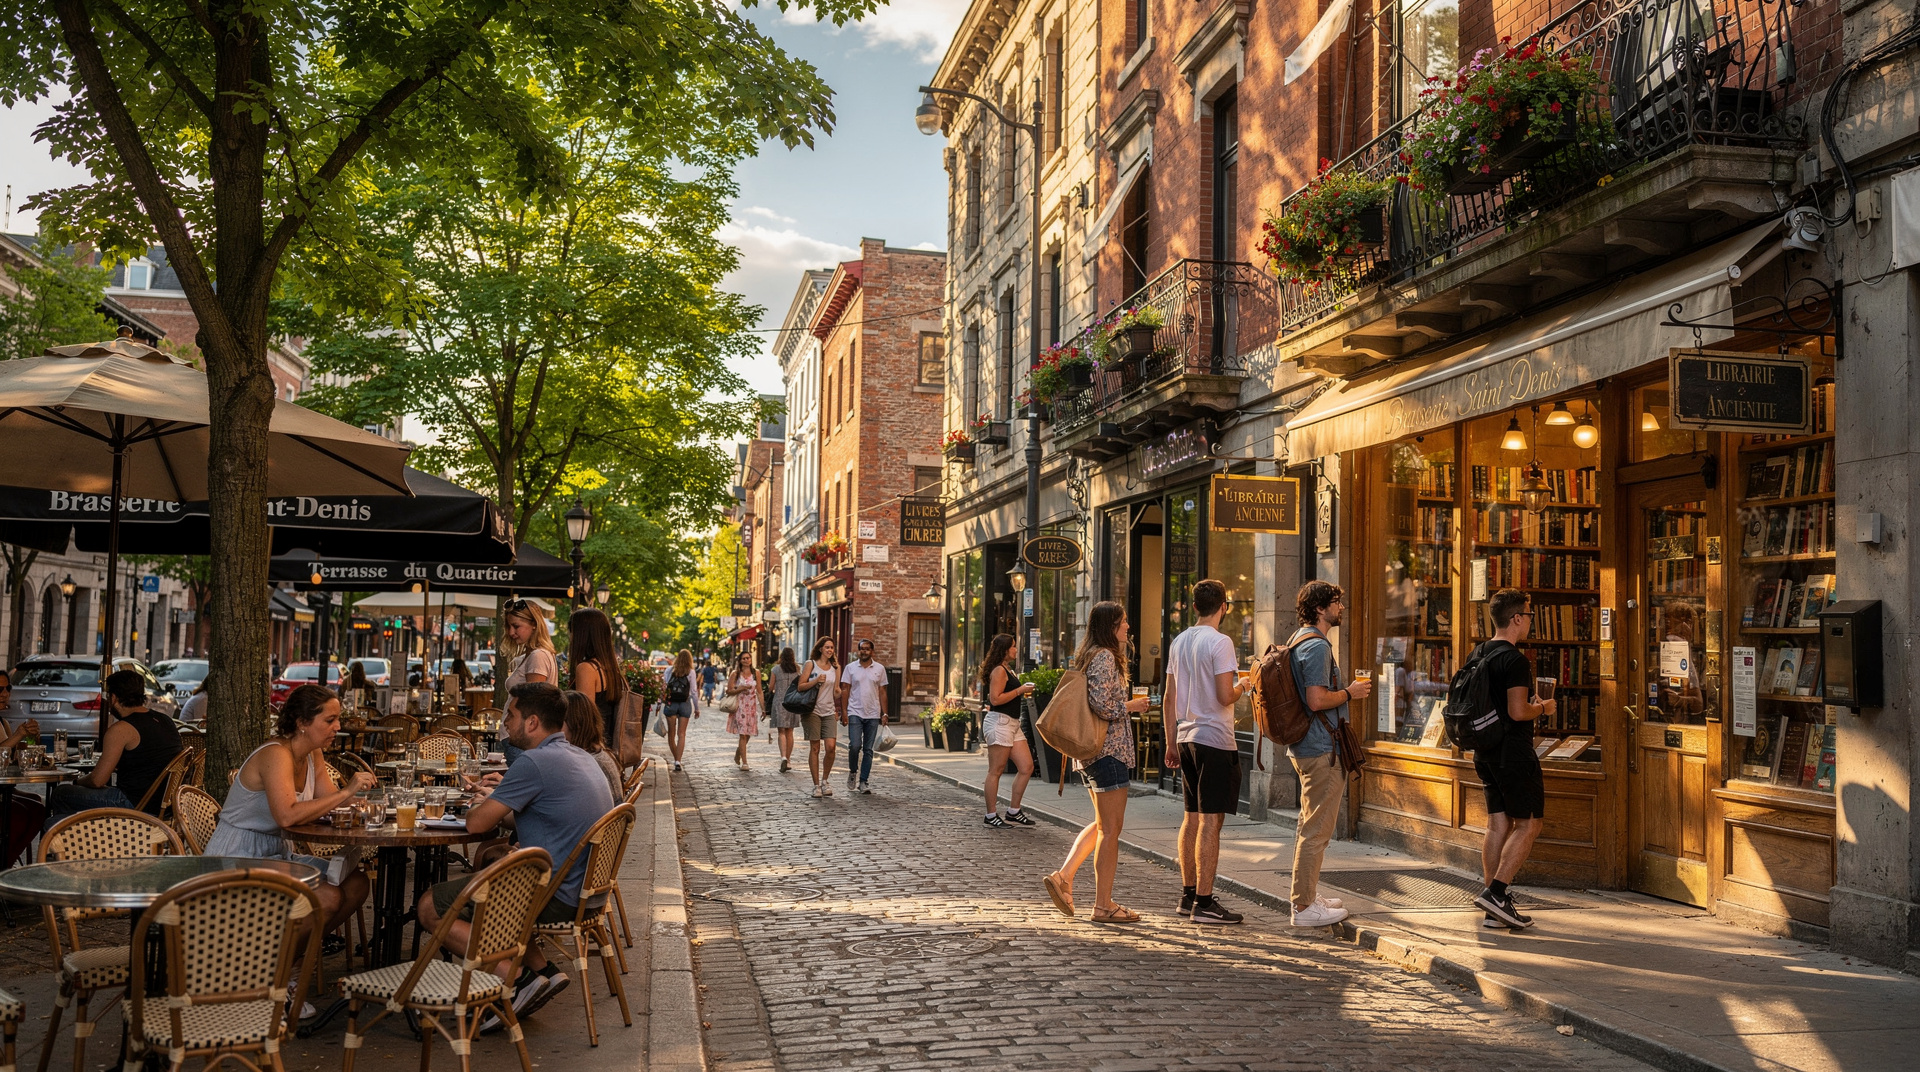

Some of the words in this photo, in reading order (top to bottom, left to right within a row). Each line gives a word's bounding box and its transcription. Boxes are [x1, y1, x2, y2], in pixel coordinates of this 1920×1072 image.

[1706, 361, 1776, 385] LIBRAIRIE
[1458, 373, 1504, 416] Saint
[1509, 358, 1562, 401] Denis
[1235, 506, 1286, 523] ANCIENNE
[308, 562, 388, 578] Terrasse
[403, 562, 427, 578] du
[436, 563, 517, 581] Quartier
